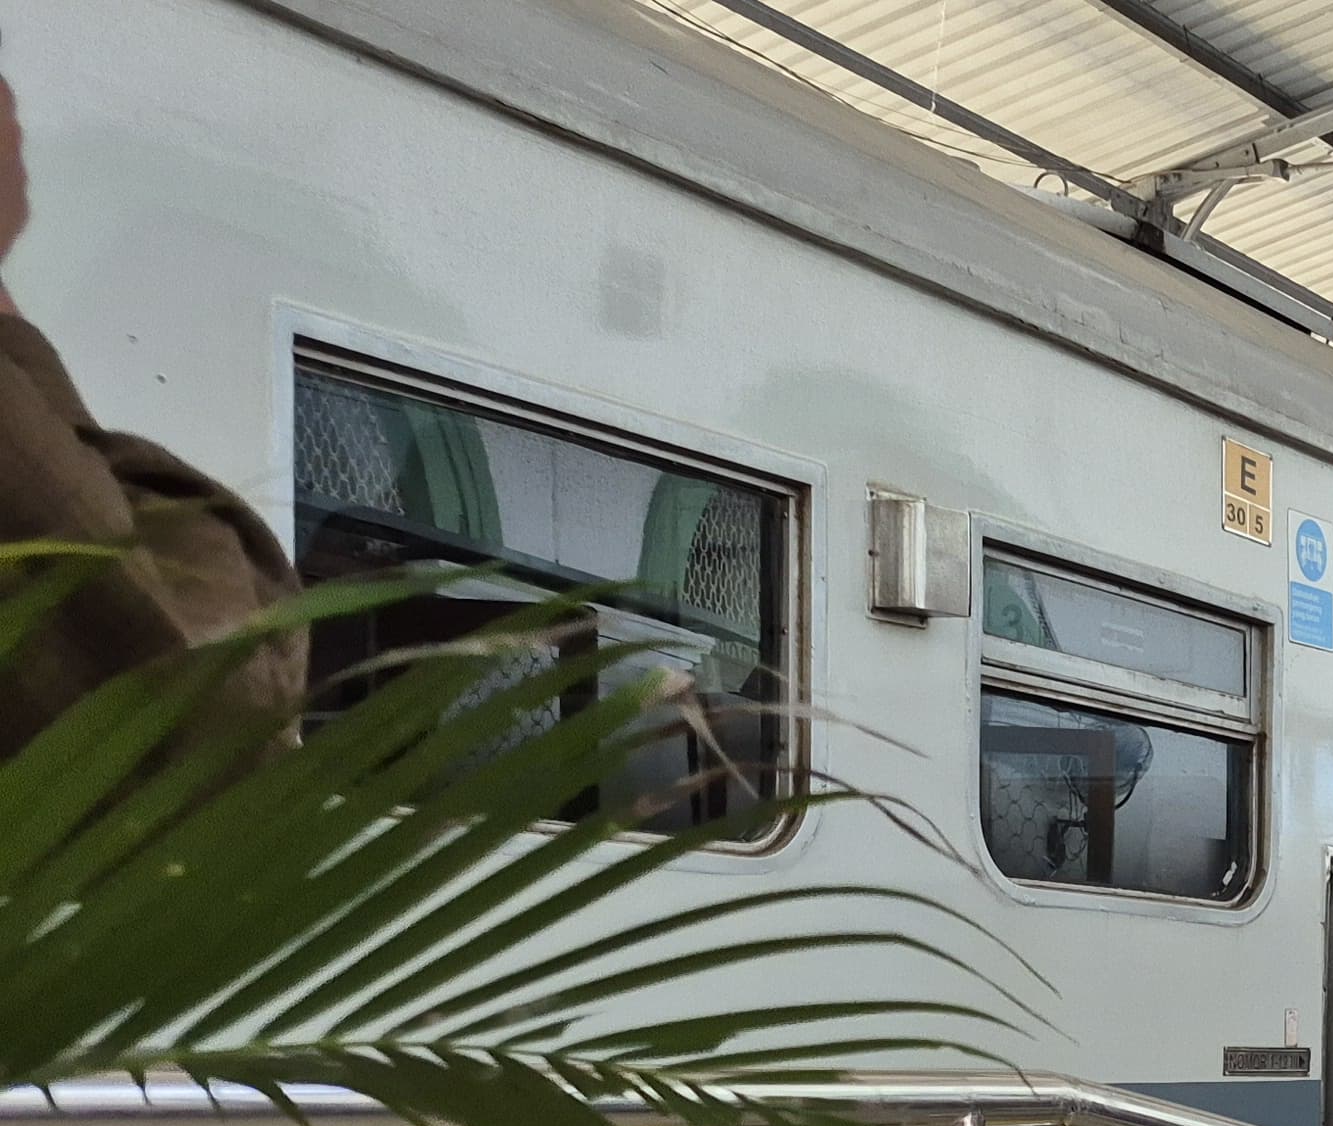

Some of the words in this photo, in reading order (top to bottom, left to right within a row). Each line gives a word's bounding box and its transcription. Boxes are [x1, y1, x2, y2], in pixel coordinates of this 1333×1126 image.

[1240, 455, 1257, 496] E
[1226, 503, 1246, 526] 30
[1254, 515, 1264, 534] 5
